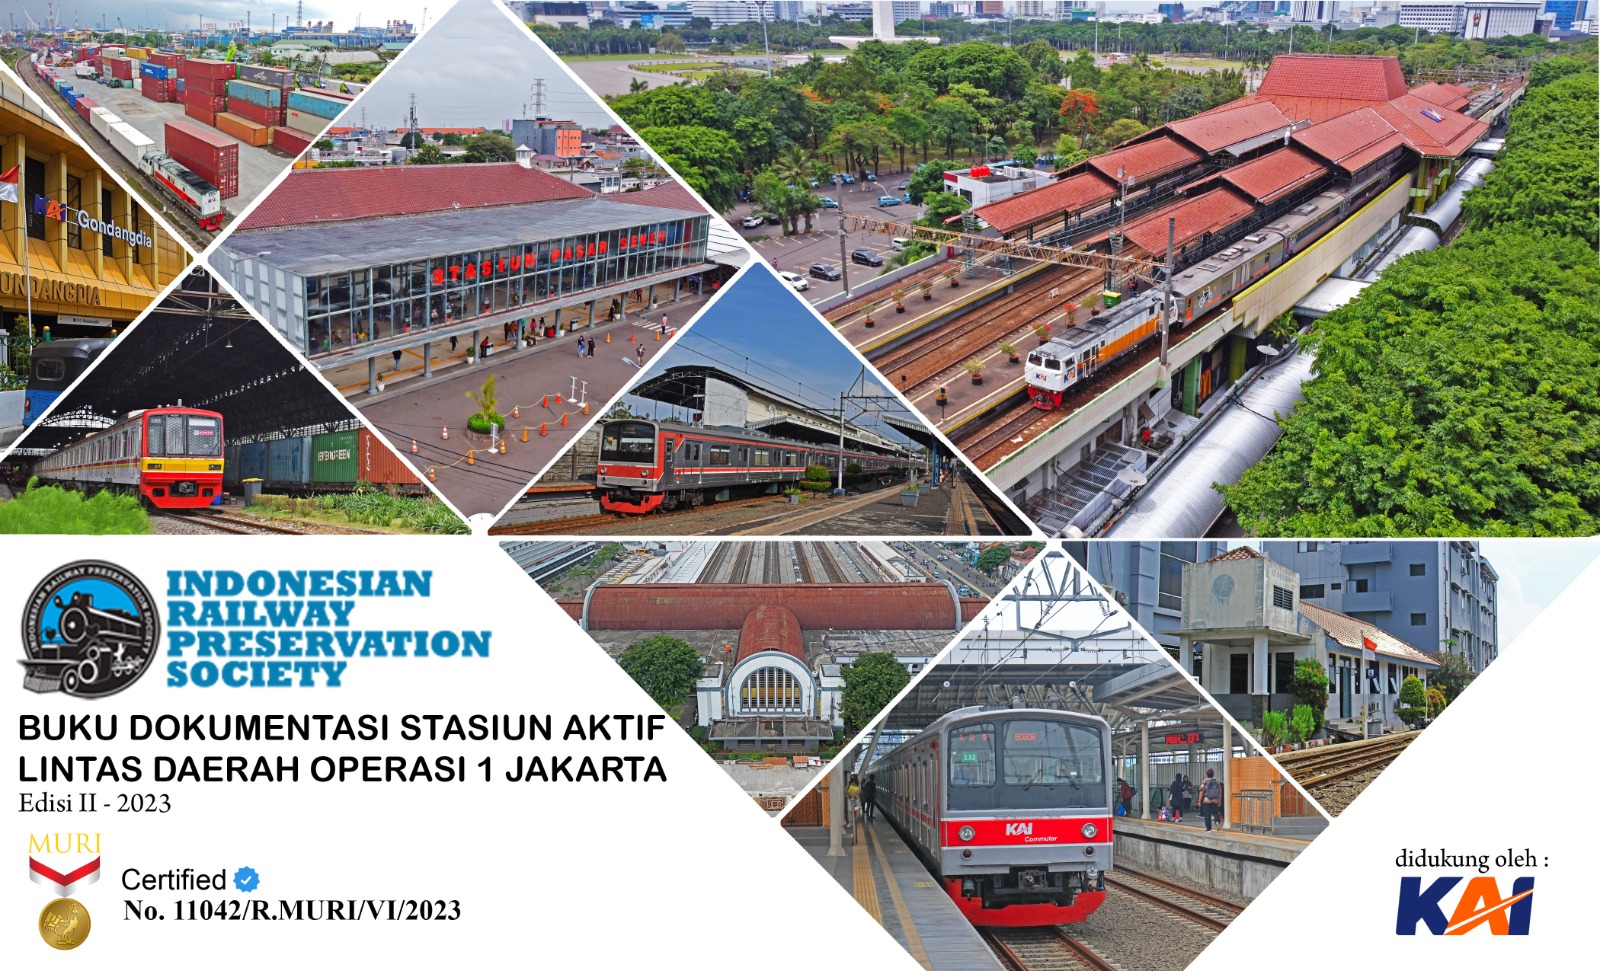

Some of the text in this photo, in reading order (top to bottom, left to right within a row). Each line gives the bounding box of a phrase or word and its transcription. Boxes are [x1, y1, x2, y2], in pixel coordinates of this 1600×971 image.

[33, 193, 67, 222] KAI
[77, 210, 152, 248] Gondangdia
[432, 230, 666, 285] STASIUN PASAR SENEN
[1006, 822, 1033, 836] KAI
[1024, 835, 1058, 843] Commuter
